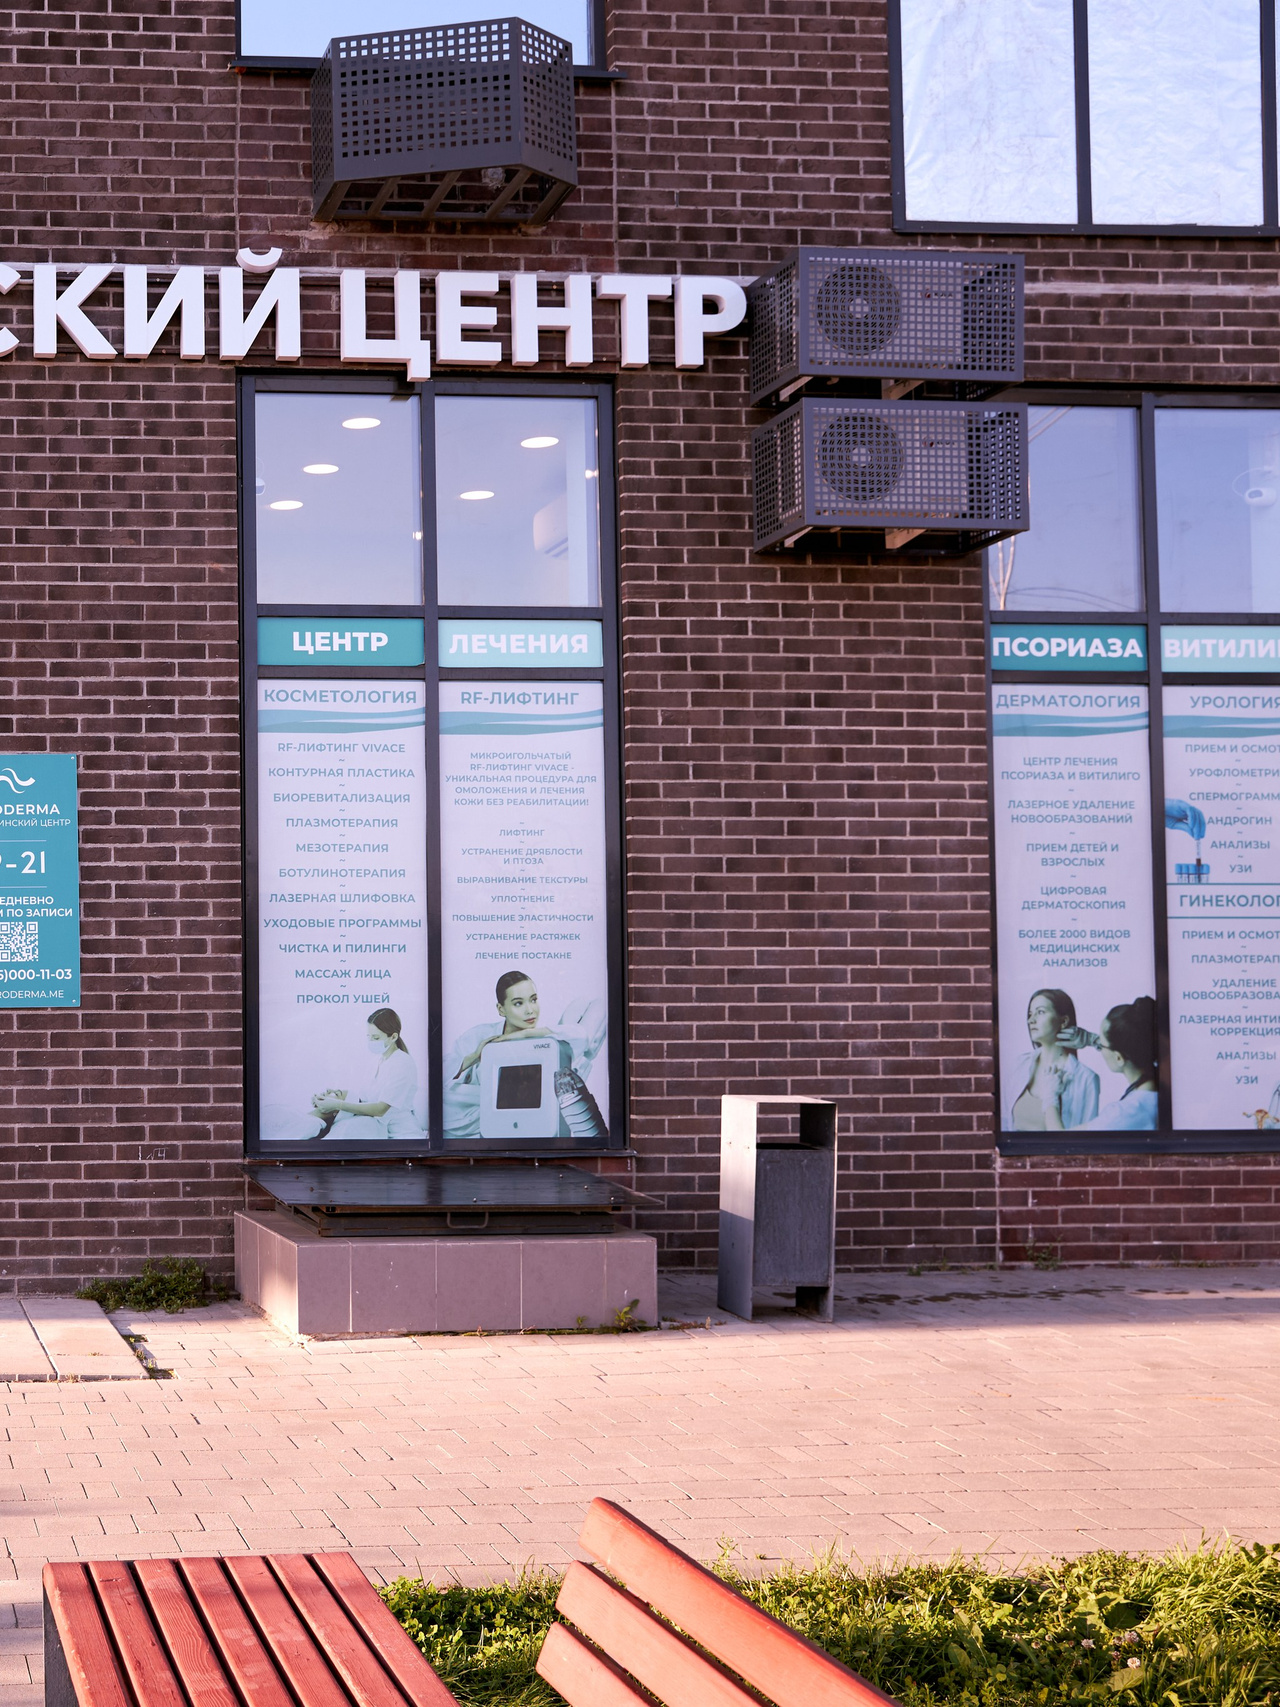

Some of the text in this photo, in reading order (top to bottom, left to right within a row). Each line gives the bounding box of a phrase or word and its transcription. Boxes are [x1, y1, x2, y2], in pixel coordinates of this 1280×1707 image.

[339, 269, 748, 382] ЦЕНТР
[293, 632, 588, 654] ЦЕНТР ЛЕЧЕНИЯ
[993, 637, 1280, 658] ПСОРИАЗА ВИТИЛИ
[265, 690, 416, 703] КОСМЕТОЛОГИЯ
[461, 692, 579, 705] RF-ЛИФТИНГ
[996, 694, 1140, 708] ДЕРМАТОЛОГИЯ
[278, 743, 405, 752] RF-ЛИФТИНГ VIVACE
[1185, 744, 1226, 753] ПРИЕМ
[471, 752, 571, 760] МИКРОИГОЛЬЧАТЫЙ
[1023, 757, 1117, 767] ЦЕНТР ЛЕЧЕНИЯ
[269, 768, 414, 777] КОНТУРНАЯ ПЛАСТИКА
[1001, 771, 1140, 780] ПСОРИАЗА И ВИТИЛИГО
[515, 775, 573, 783] ПРОЦЕДУРА
[576, 776, 596, 784] ДЛЯ
[274, 793, 410, 802] БИОРЕВИТАЛИЗАЦИЯ
[1008, 800, 1134, 810] ЛАЗЕРНОЕ УДАЛЕНИЕ
[286, 818, 398, 827] ПЛАЗМОТЕРАПИЯ
[1011, 813, 1132, 823] НОВООБРАЗОВАНИЙ
[1208, 816, 1272, 826] АНДРОГИН
[41, 819, 70, 827] ЦЕНТР
[499, 829, 545, 837] ЛИФТИНГ
[296, 844, 388, 852] МЕЗОТЕРАПИЯ
[1027, 842, 1119, 853] ПРИЕМ ДЕТЕЙ И
[1211, 840, 1270, 849] АНАЛИЗЫ
[526, 848, 582, 856] ДРЯБЛОСТИ
[1041, 858, 1104, 866] ВЗРОСЛЫХ
[279, 869, 405, 877] БОТУЛИНОТЕРАПИЯ
[1230, 864, 1252, 873] УЗИ
[1041, 886, 1106, 896] ЦИФРОВАЯ
[269, 894, 415, 903] ЛАЗЕРНАЯ ШЛИФОВКА
[1022, 901, 1125, 910] ДЕРМАТОСКОПИЯ
[7, 909, 23, 917] ПО
[26, 908, 72, 917] ЗАПИСИ
[264, 919, 421, 929] УХОДОВЫЕ ПРОГРАММЫ
[1019, 930, 1130, 939] БОЛЕЕ 2000 ВИДОВ
[1182, 931, 1223, 939] ПРИЕМ
[1227, 931, 1235, 939] И
[279, 944, 406, 953] ЧИСТКА И ПИЛИНГИ
[1030, 944, 1120, 954] МЕДИЦИНСКИХ
[1043, 958, 1107, 967] АНАЛИЗОВ
[295, 970, 391, 979] МАССАЖ ЛИЦА
[1213, 979, 1276, 988] УДАЛЕНИЕ
[297, 993, 389, 1003] ПРОКОЛ УШЕЙ
[1179, 1015, 1241, 1024] ЛАЗЕРНАЯ
[1217, 1051, 1276, 1060] АНАЛИЗЫ
[1236, 1076, 1258, 1084] УЗИ
